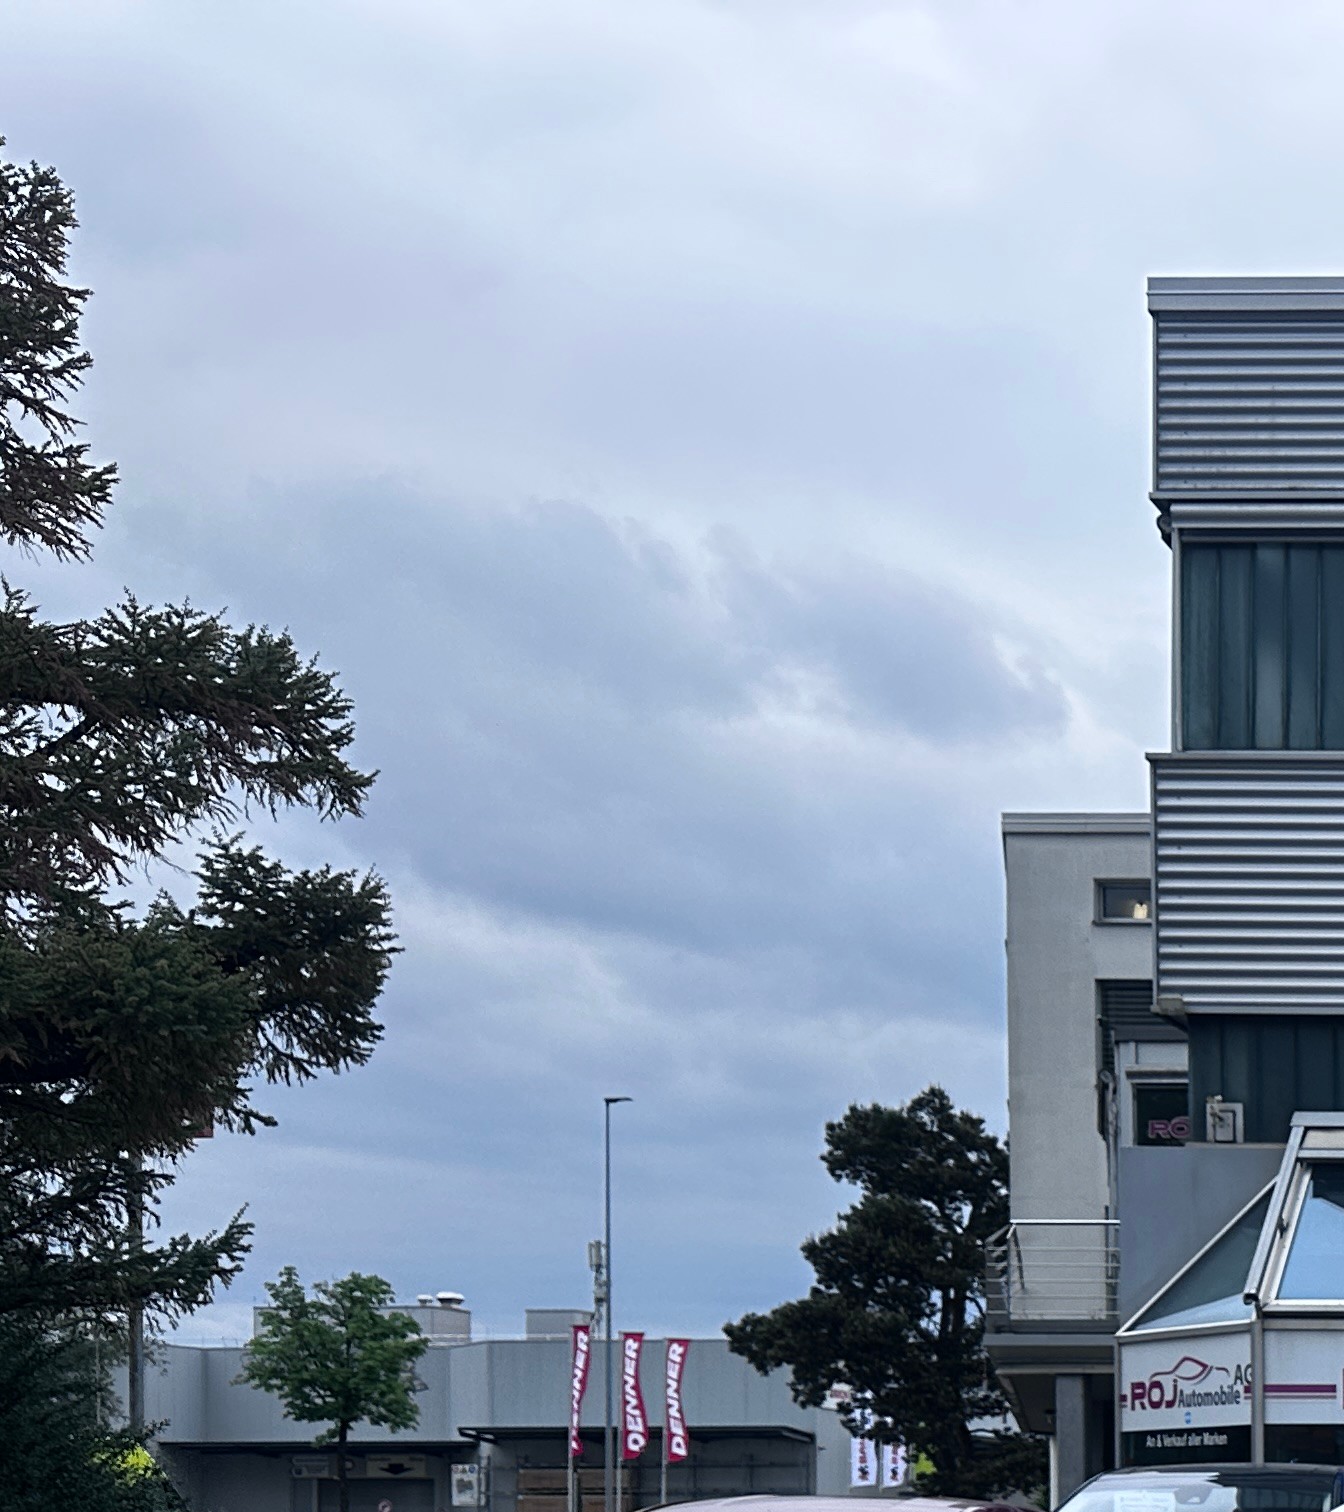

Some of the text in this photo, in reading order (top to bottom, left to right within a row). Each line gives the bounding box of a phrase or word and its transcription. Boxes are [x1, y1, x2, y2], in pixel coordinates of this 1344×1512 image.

[622, 1338, 647, 1453] DENNER
[666, 1342, 688, 1457] DENNER
[1131, 1379, 1178, 1411] ROJ
[1178, 1384, 1241, 1408] Automobile
